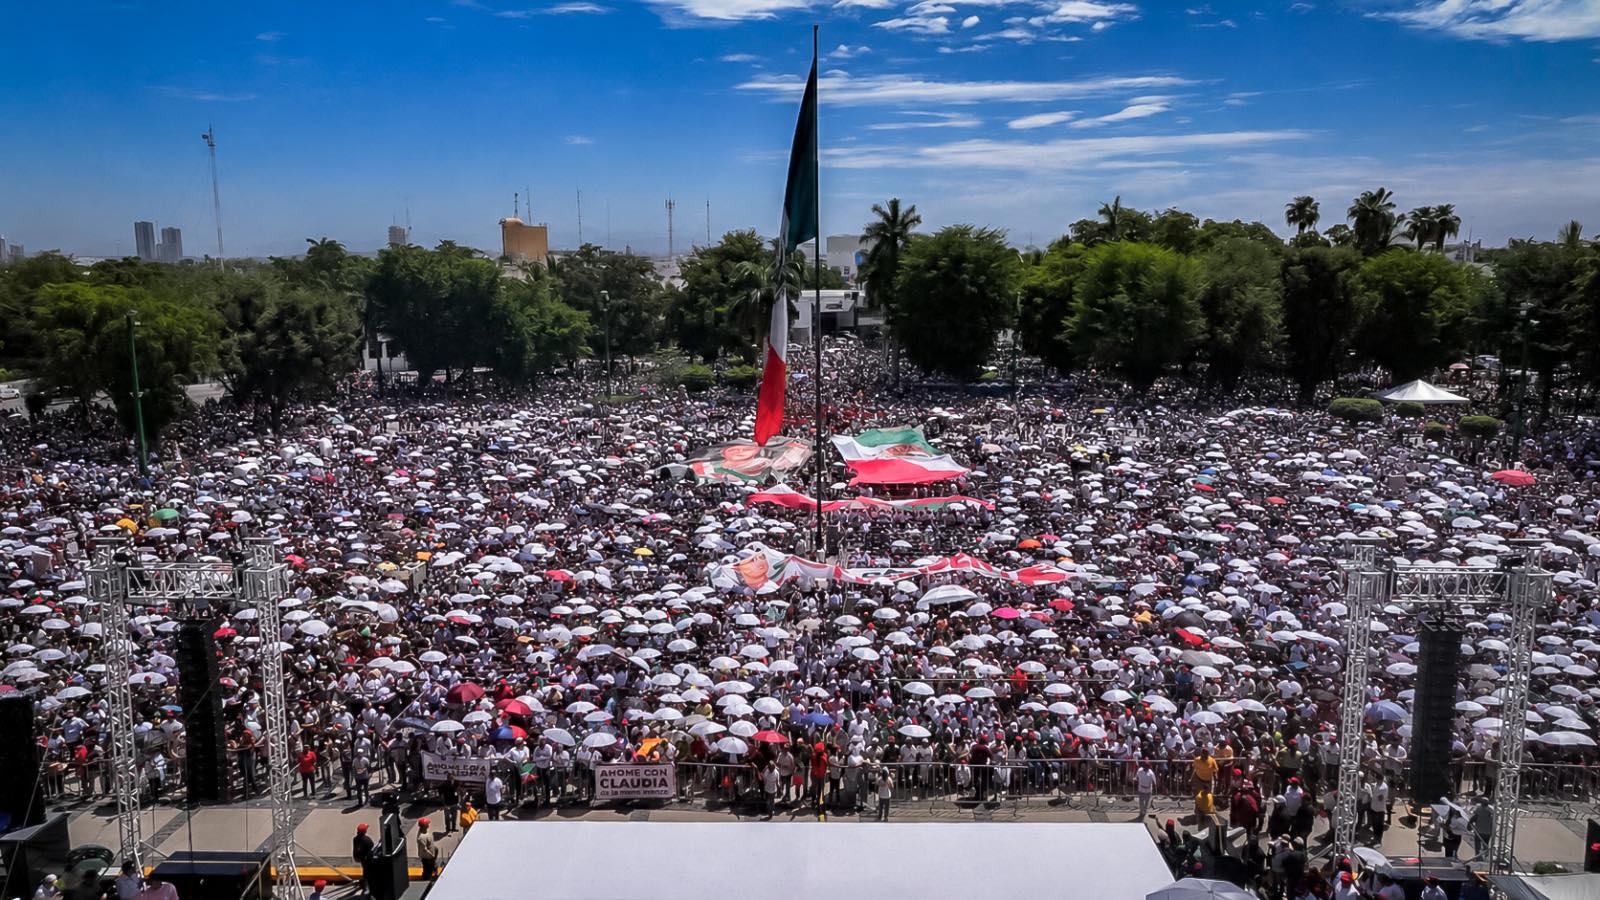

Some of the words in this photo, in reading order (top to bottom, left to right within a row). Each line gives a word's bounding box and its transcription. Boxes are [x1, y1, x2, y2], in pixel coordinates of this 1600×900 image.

[600, 769, 640, 777] AHOME
[644, 769, 668, 777] CON
[600, 778, 668, 789] CLAUDIA
